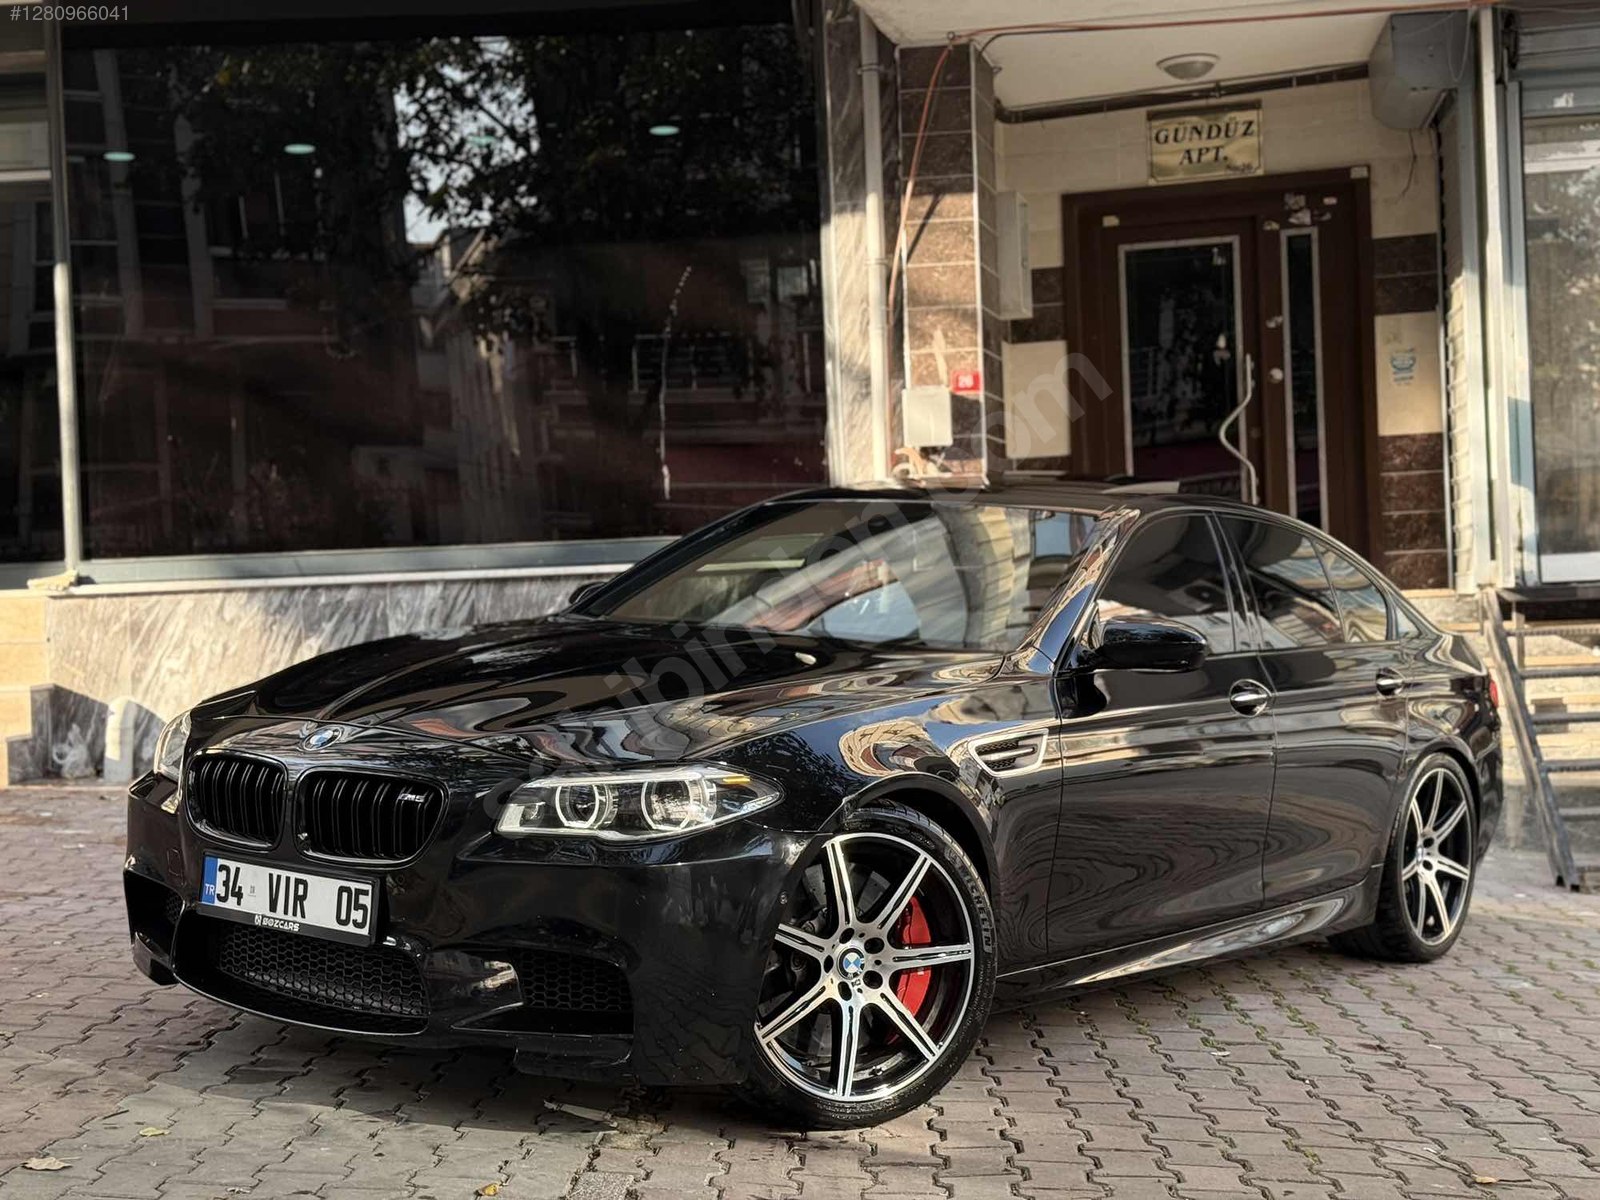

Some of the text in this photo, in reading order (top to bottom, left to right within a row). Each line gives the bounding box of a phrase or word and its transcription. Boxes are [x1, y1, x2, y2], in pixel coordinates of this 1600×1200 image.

[1155, 117, 1254, 144] GÜNDÜZ
[1179, 145, 1228, 165] APT.
[205, 883, 215, 896] TR
[216, 864, 370, 929] 34 VIR 05
